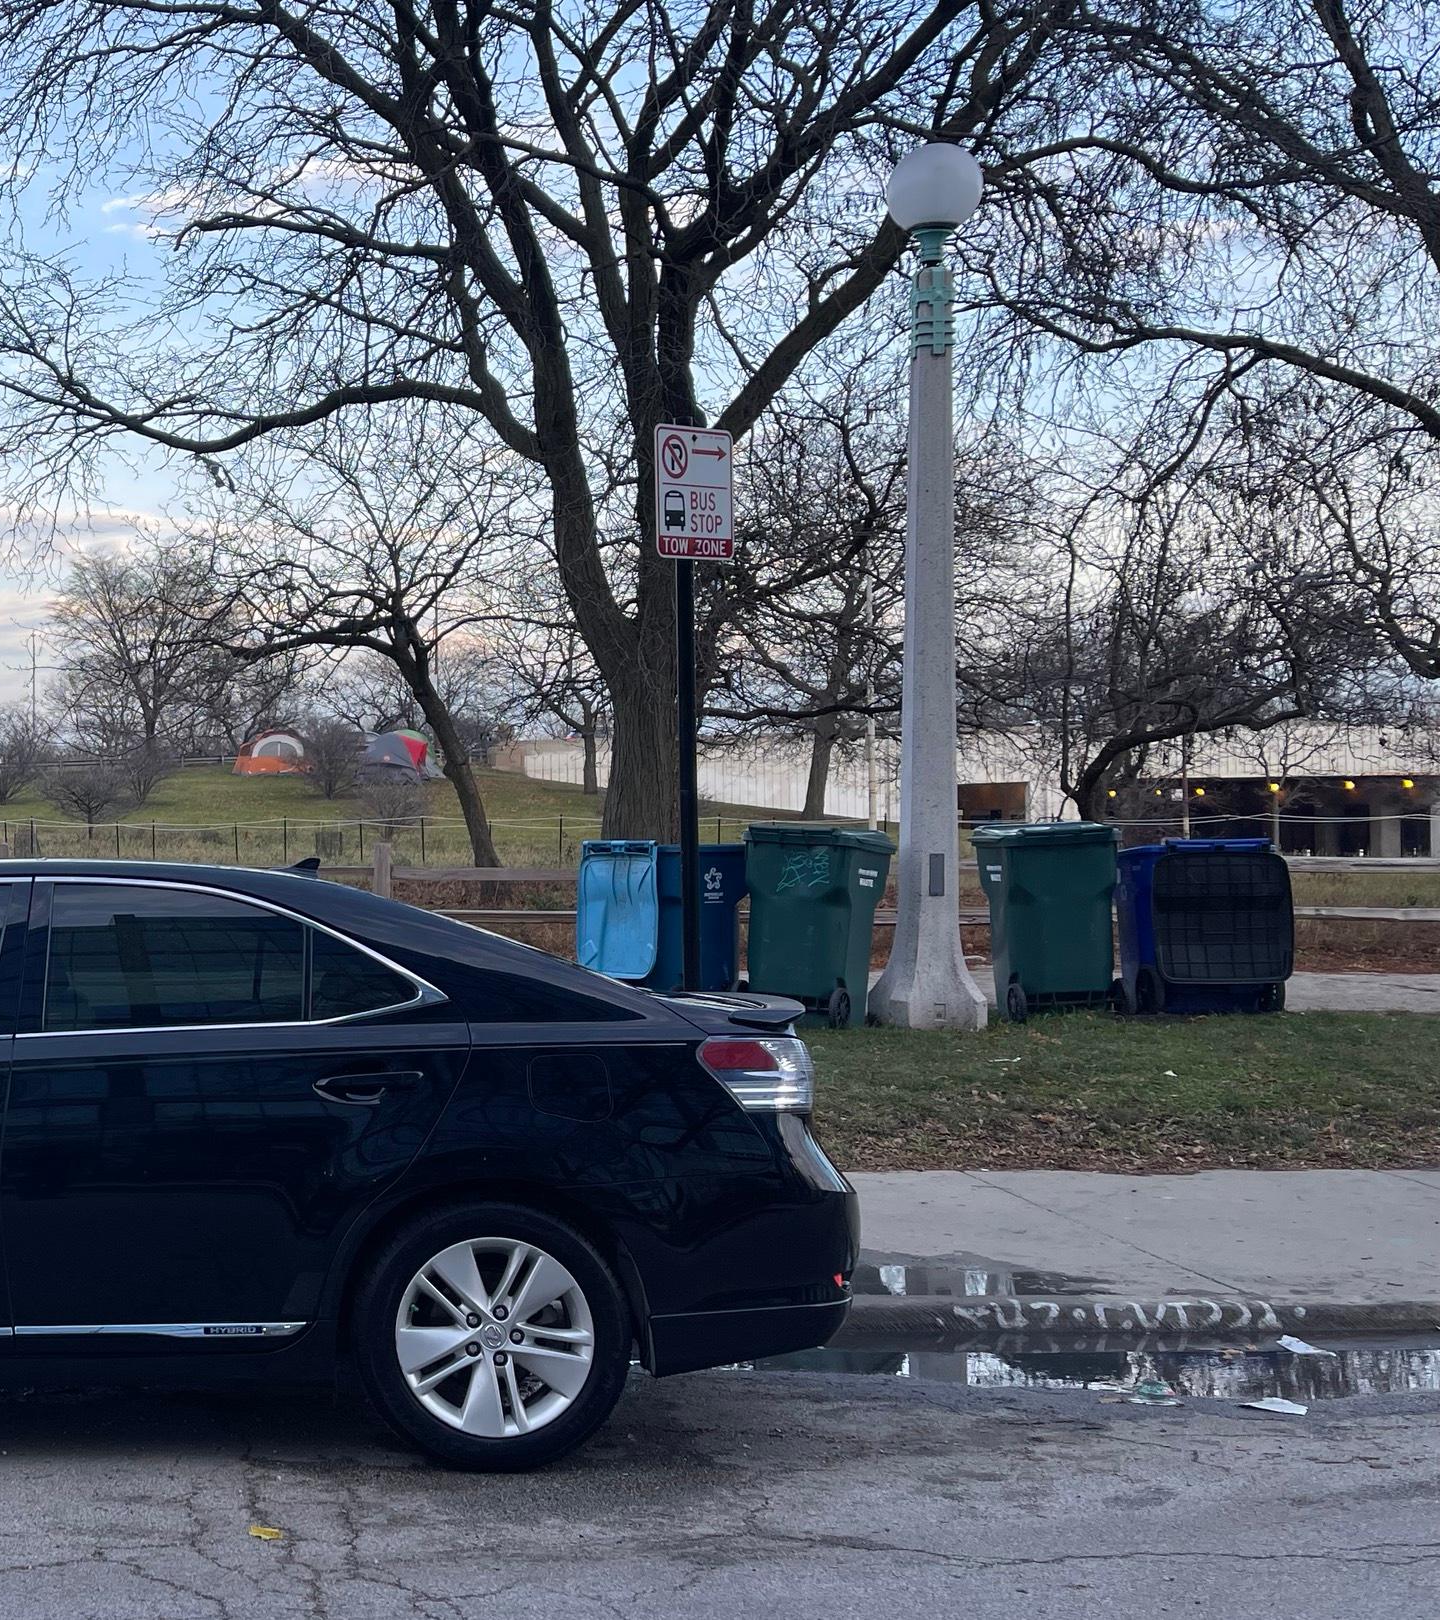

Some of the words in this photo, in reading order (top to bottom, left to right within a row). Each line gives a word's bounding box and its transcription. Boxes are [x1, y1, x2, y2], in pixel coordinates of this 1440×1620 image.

[690, 491, 716, 511] BUS
[690, 513, 723, 533] STOP
[662, 537, 689, 554] TOW
[695, 539, 727, 556] ZONE
[210, 1326, 256, 1334] HYBRID
